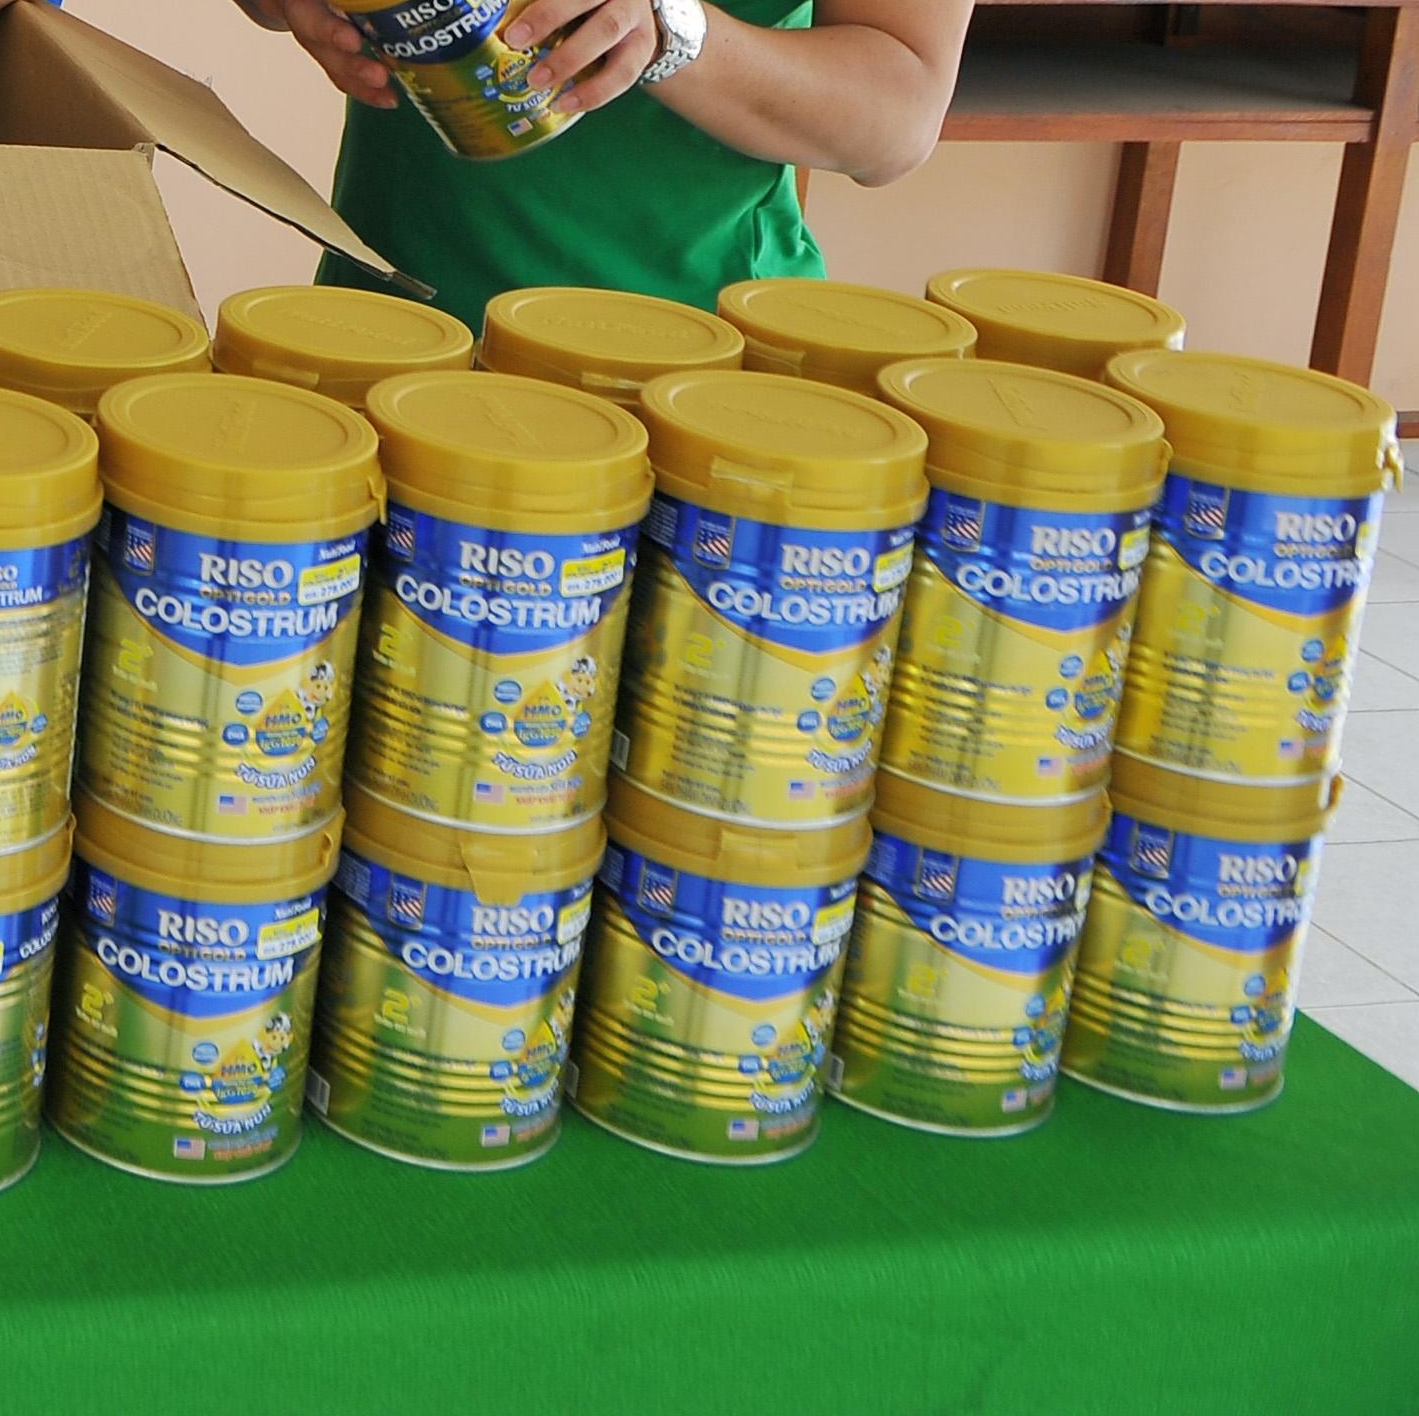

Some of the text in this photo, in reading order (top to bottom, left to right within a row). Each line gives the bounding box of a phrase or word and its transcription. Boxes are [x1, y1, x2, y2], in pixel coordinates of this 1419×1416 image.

[1030, 525, 1117, 559] RISO
[1274, 510, 1356, 544] RISO
[198, 552, 295, 589] RISO
[460, 540, 556, 580] RISO
[781, 544, 870, 577] RISO
[135, 587, 339, 638] COLOSTRUM
[395, 575, 602, 630] COLOSTRUM
[1217, 854, 1298, 885] RISO
[1001, 873, 1076, 907] RISO
[158, 909, 249, 945] RISO
[471, 904, 555, 935] RISO
[722, 898, 810, 930] RISO
[97, 937, 295, 994] COLOSTRUM
